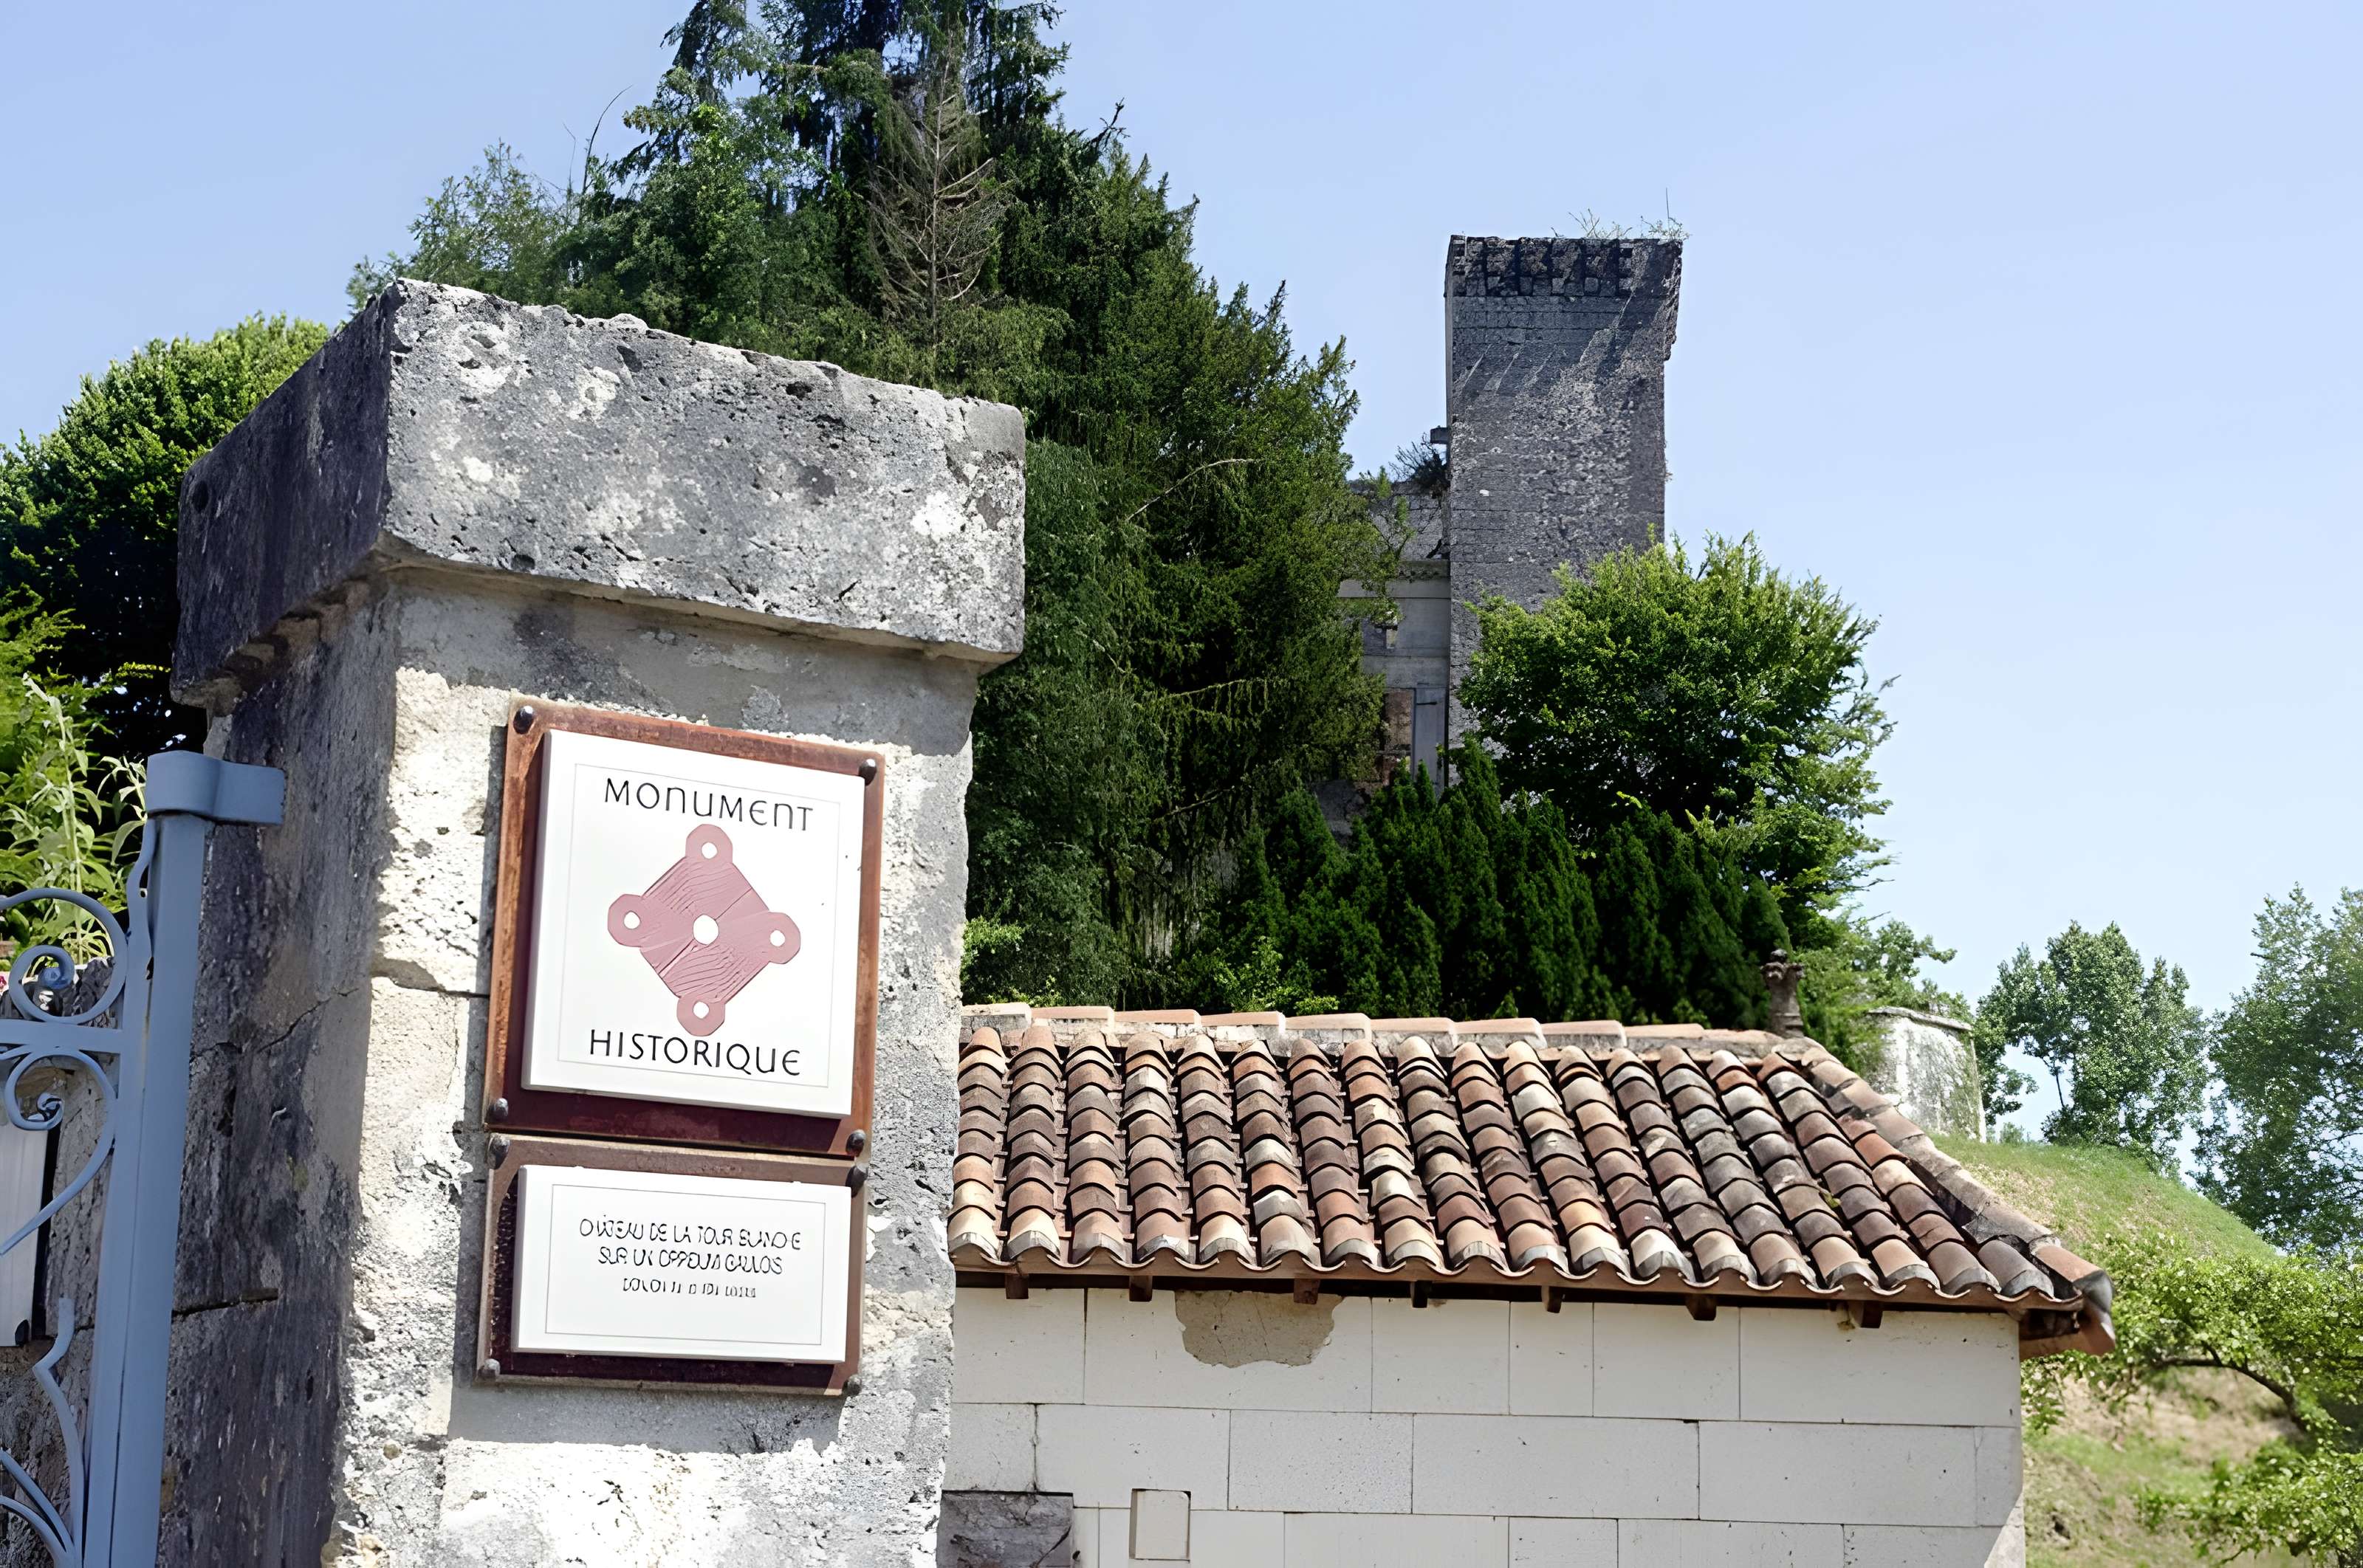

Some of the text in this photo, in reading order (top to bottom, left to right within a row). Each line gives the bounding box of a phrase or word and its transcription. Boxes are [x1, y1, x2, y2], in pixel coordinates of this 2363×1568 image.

[604, 777, 814, 831] MONUMENT
[589, 1028, 800, 1076] HISTORIQUE
[650, 1223, 668, 1242] DE
